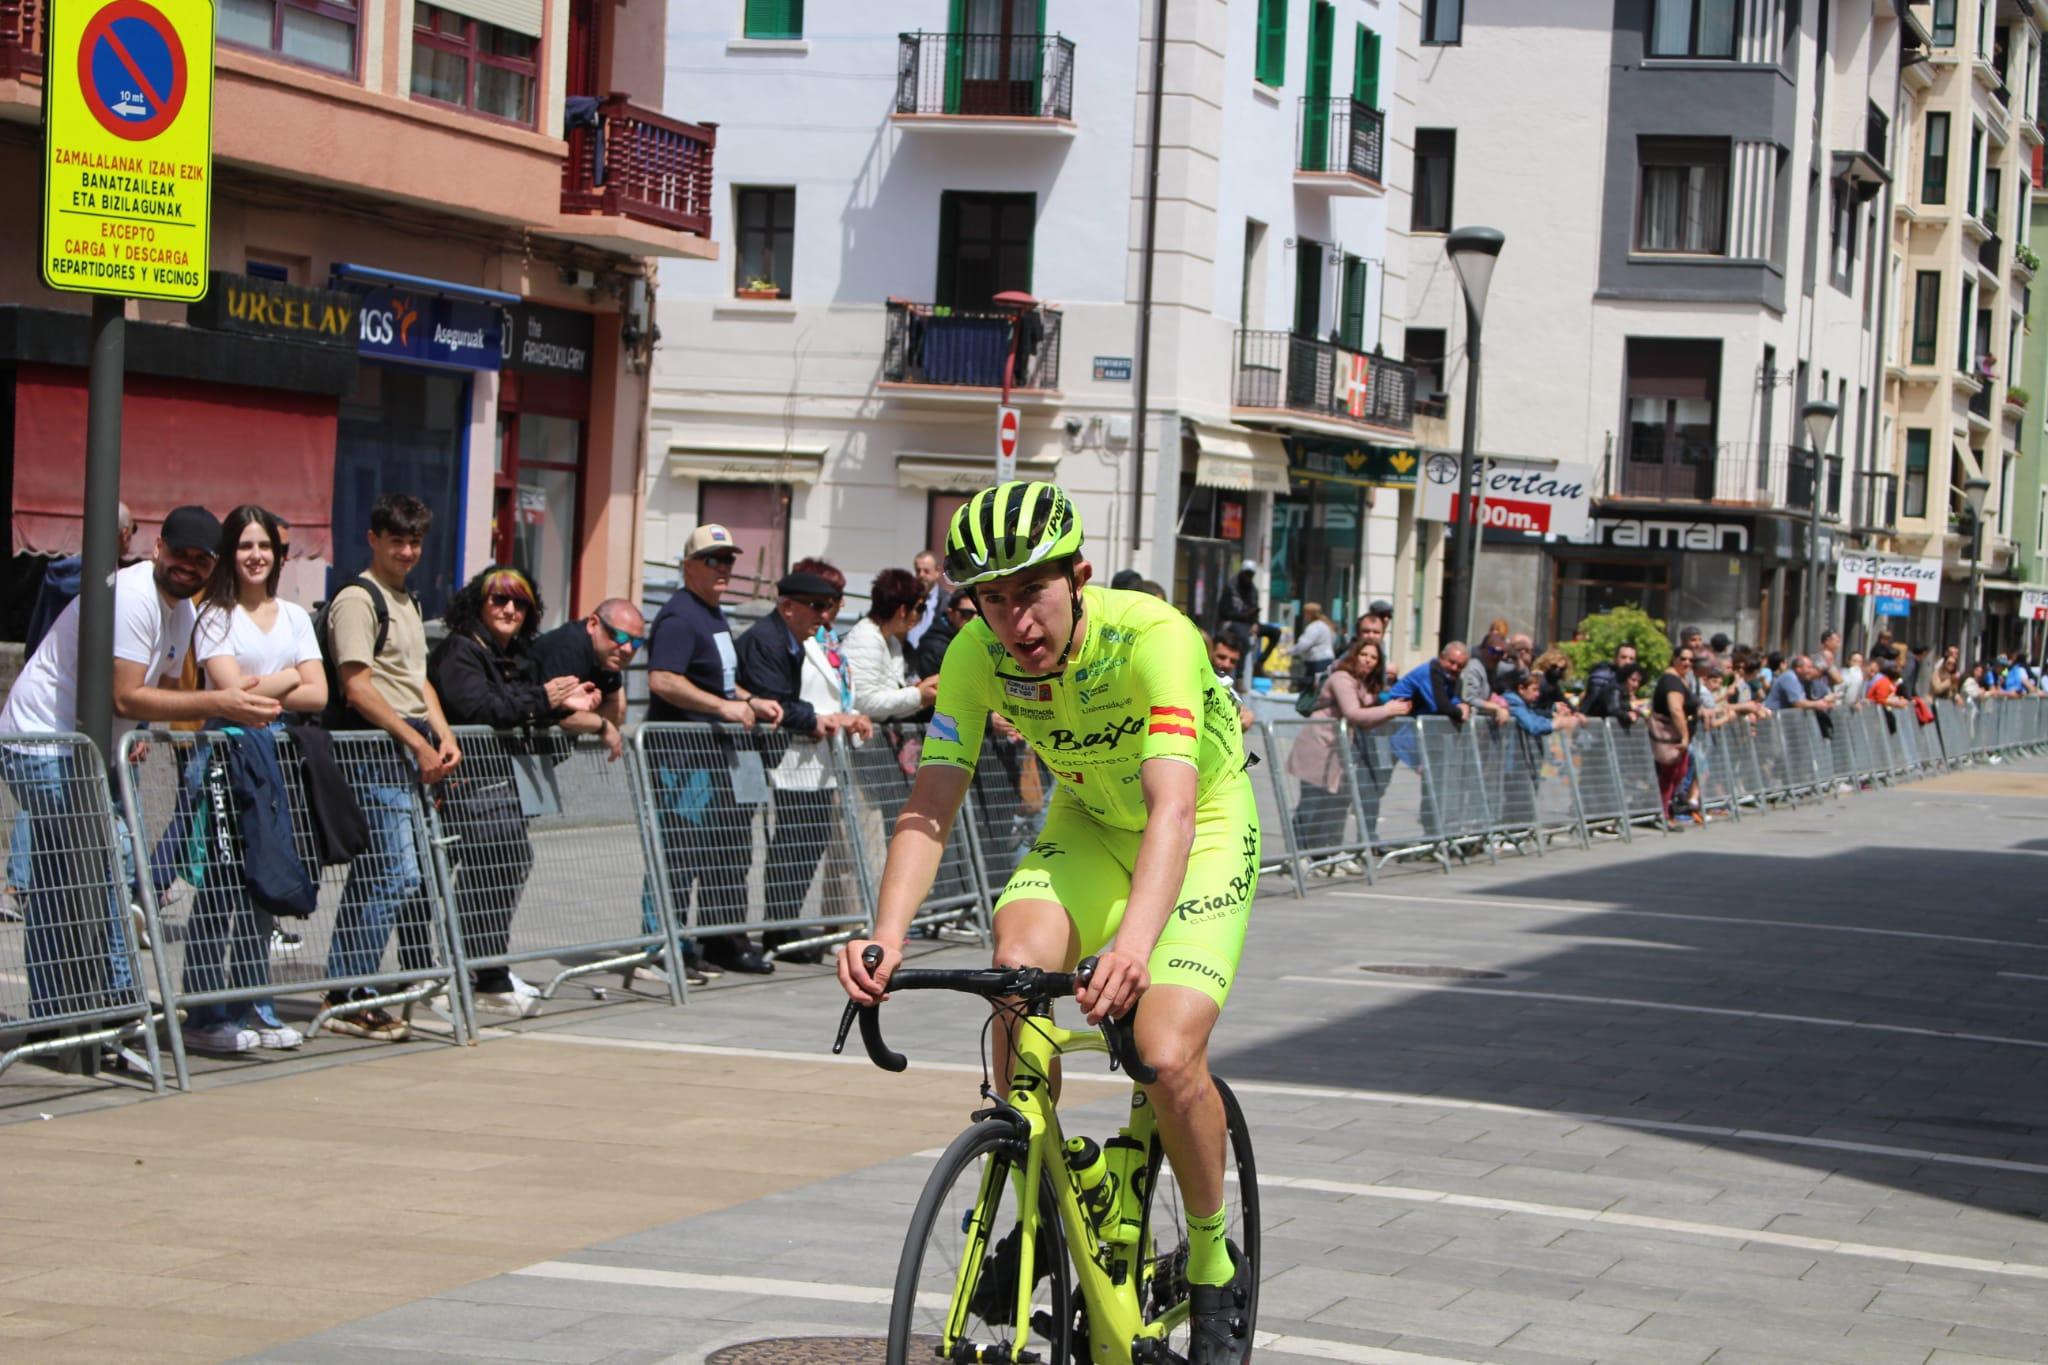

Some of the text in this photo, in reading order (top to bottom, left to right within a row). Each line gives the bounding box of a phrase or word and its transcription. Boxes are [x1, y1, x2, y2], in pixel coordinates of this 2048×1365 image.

[120, 91, 144, 103] 10 mt
[56, 148, 203, 181] ZAMALALANAK IZAN EZIK
[82, 172, 175, 197] BANATZAILEAK
[73, 191, 182, 217] ETA BIZILAGUNAK
[101, 222, 155, 242] EXCEPTO
[65, 239, 189, 266] CARGA Y DESCARGA
[53, 258, 199, 287] REPARTIDORES Y VECINOS
[228, 288, 351, 335] URCELAY
[434, 322, 484, 351] Aseguruak
[528, 315, 542, 338] the
[1470, 502, 1540, 530] 00m.
[1866, 557, 1936, 579] Bertan
[1003, 880, 1049, 895] mura
[1168, 958, 1227, 988] amura
